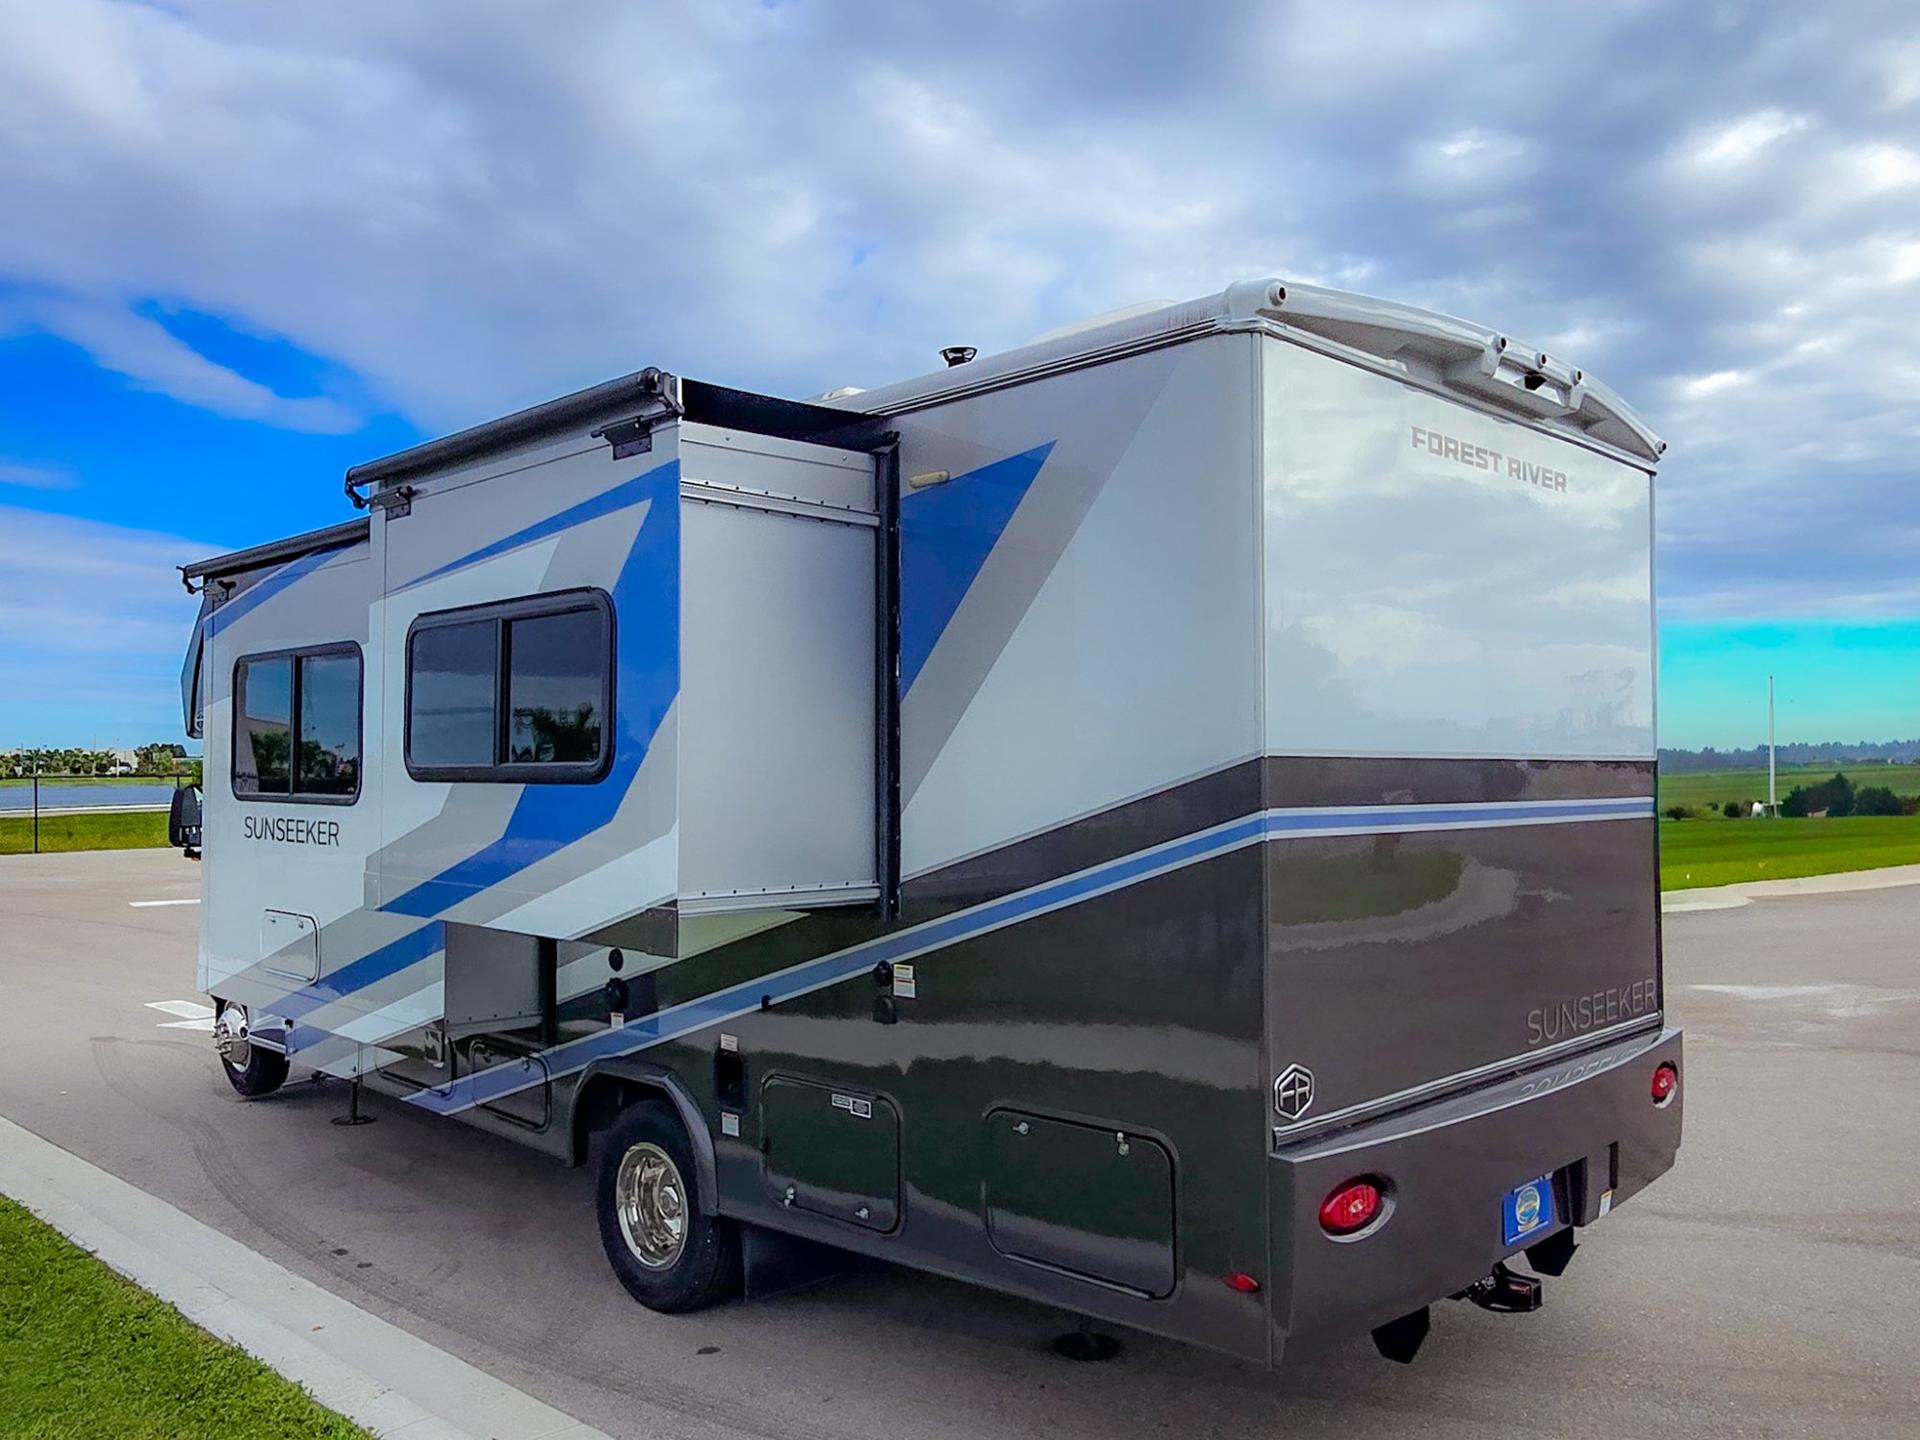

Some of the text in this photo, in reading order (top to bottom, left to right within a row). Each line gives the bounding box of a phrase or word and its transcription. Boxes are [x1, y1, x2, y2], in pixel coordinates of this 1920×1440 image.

[1411, 426, 1567, 494] FOREST RIVER
[244, 815, 340, 847] SUNSEEKER
[1527, 978, 1658, 1045] SUNSEEKER
